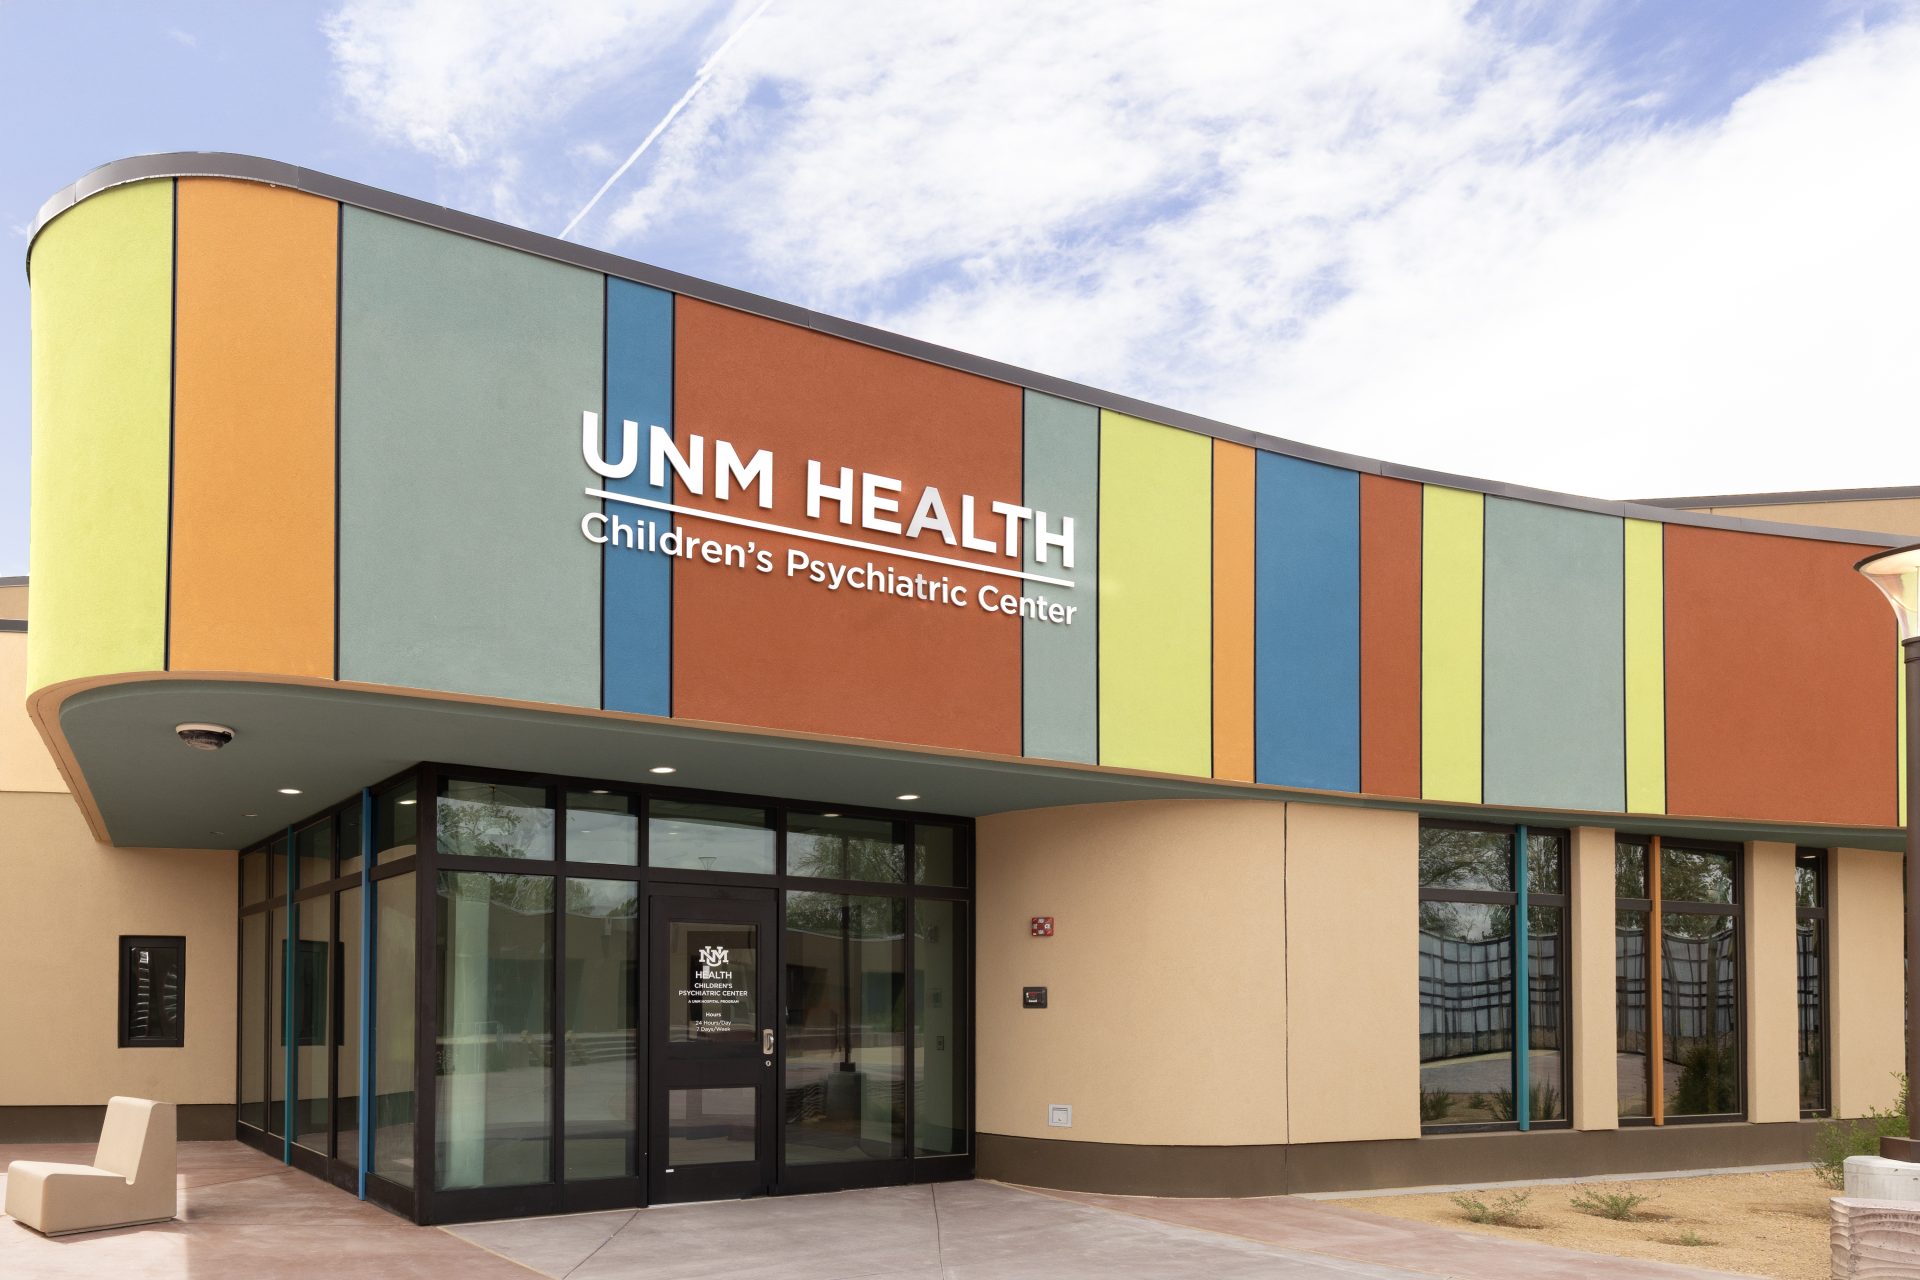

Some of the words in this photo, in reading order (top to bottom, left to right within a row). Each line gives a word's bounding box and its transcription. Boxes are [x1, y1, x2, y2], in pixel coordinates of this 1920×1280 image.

[582, 410, 773, 510] UNM
[806, 459, 1075, 569] HEALTH
[581, 512, 773, 573] Children's
[787, 549, 968, 608] Psychiatric
[978, 585, 1077, 625] Center
